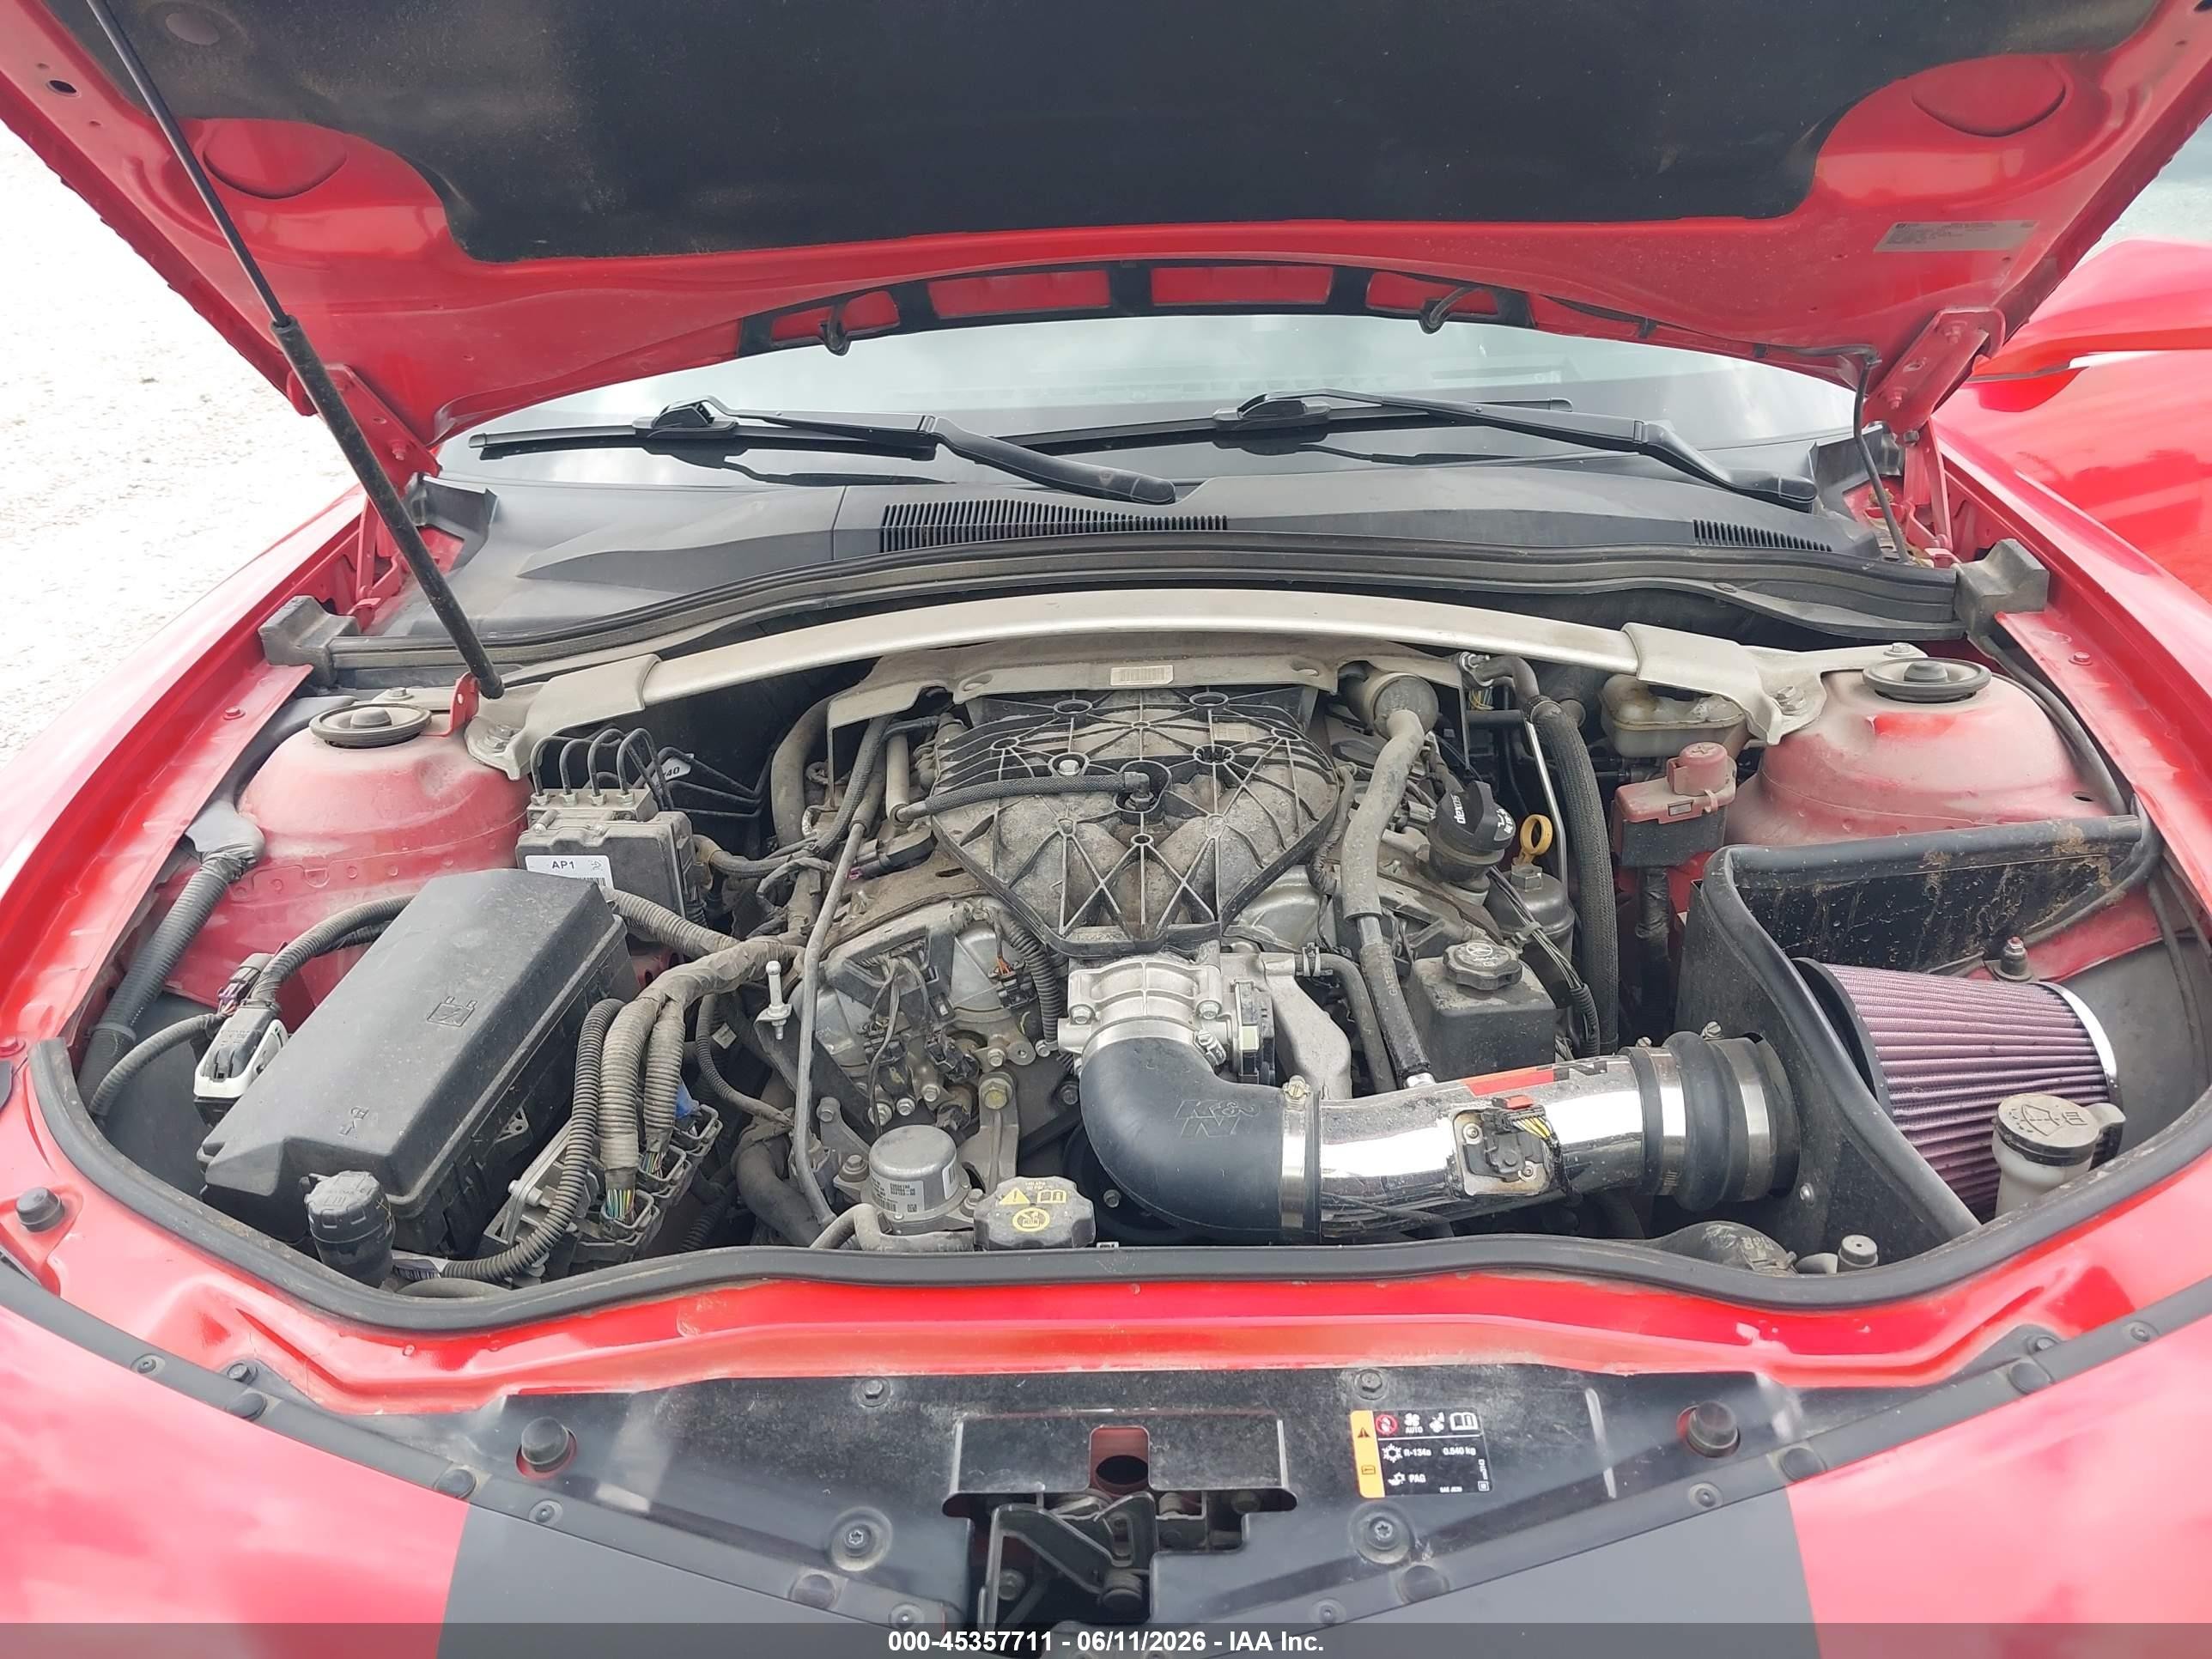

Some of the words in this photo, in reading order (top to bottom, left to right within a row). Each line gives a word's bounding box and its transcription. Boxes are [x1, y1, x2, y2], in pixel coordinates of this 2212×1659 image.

[1450, 793, 1466, 824] dexos
[551, 860, 575, 870] AP1
[1382, 967, 1398, 996] GATES
[1403, 1449, 1431, 1457] R-134a
[1465, 1447, 1477, 1455] kg
[1408, 1474, 1427, 1483] PAG
